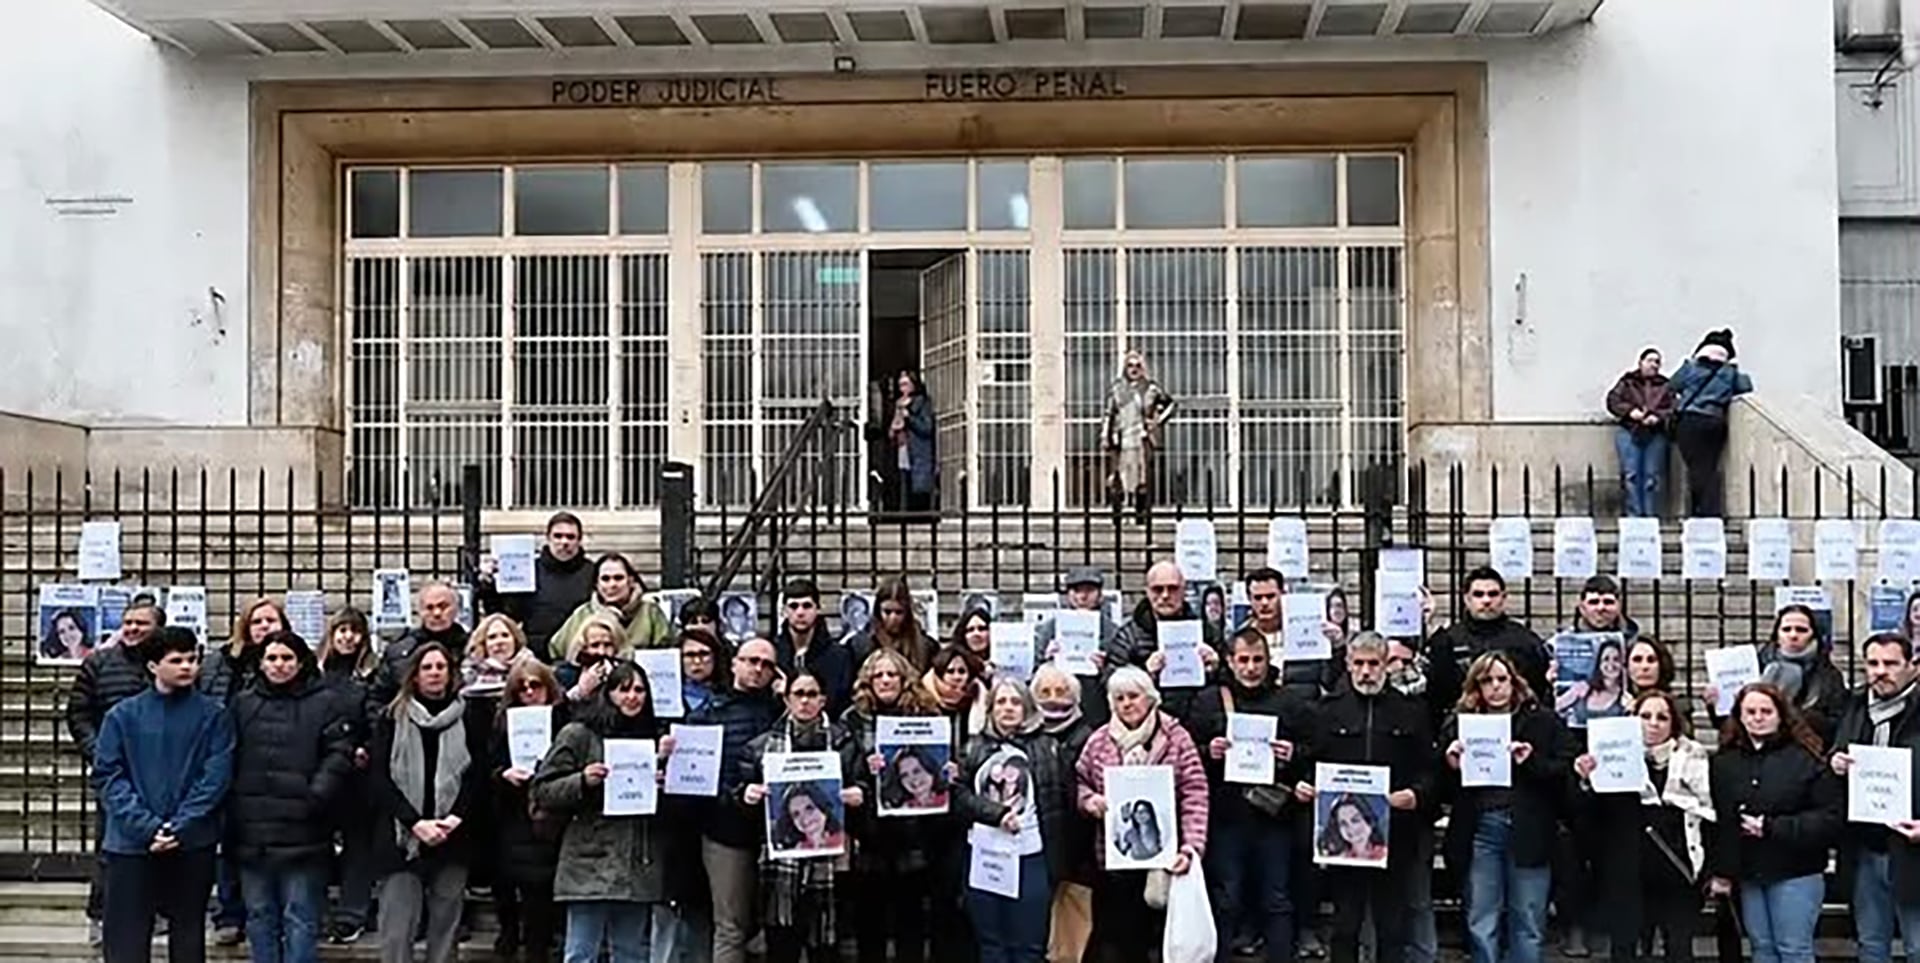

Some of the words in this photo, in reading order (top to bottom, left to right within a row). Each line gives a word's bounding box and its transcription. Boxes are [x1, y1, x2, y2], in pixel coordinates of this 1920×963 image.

[552, 80, 640, 102] PODER
[658, 78, 782, 101] JUDICIAL
[925, 73, 1017, 98] FUERO
[1034, 71, 1126, 96] PENAL
